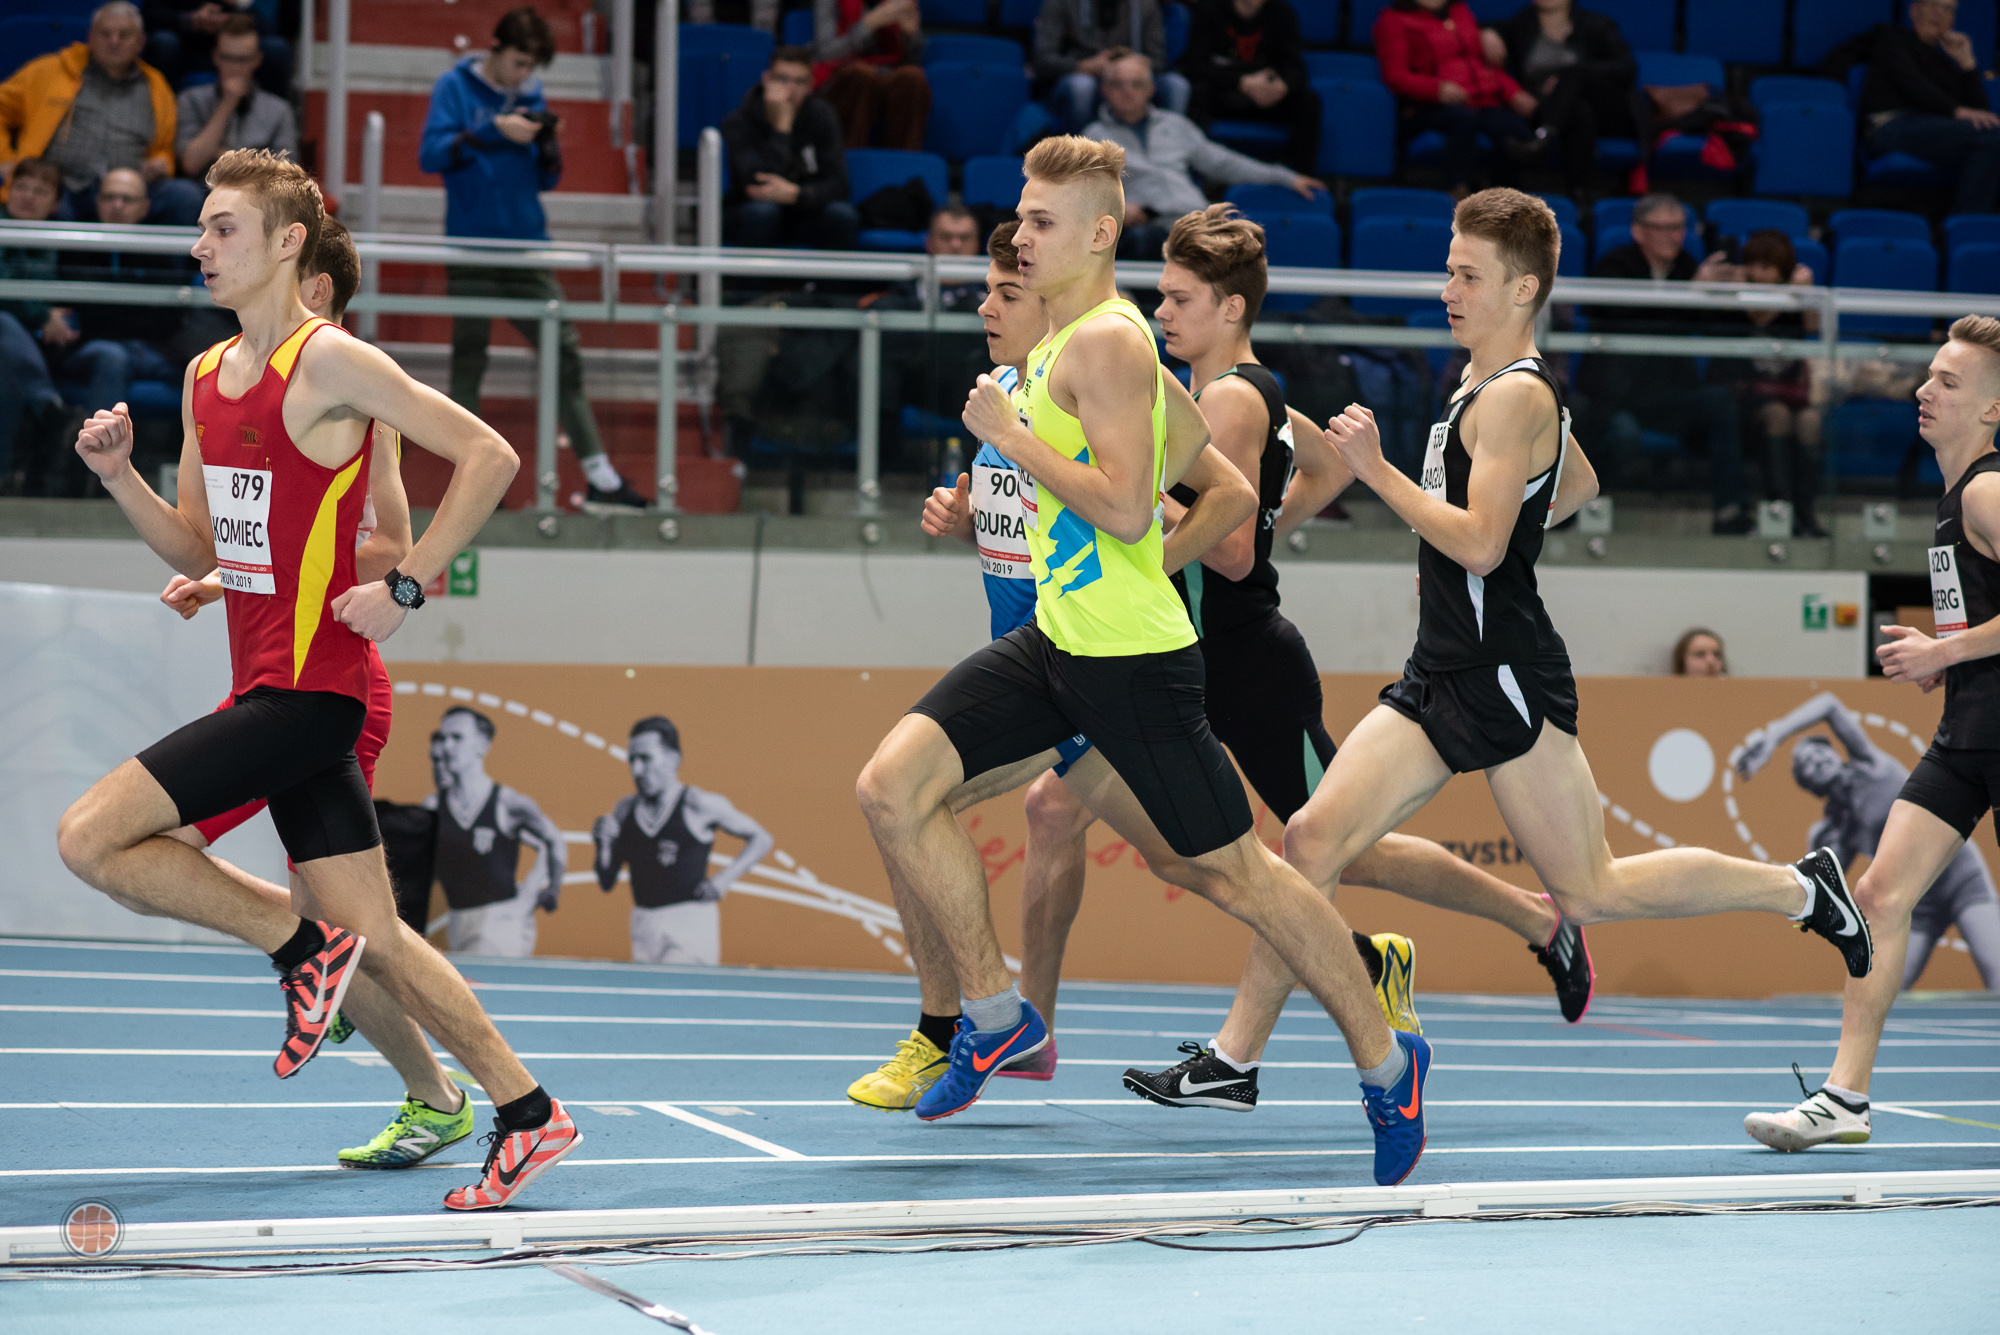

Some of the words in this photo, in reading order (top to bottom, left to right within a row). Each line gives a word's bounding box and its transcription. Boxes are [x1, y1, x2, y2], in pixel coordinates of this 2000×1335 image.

[231, 472, 265, 501] 879
[212, 516, 264, 548] KOMIEC
[972, 505, 1027, 541] ODURA
[236, 574, 252, 589] 2019
[992, 561, 1014, 575] 2019
